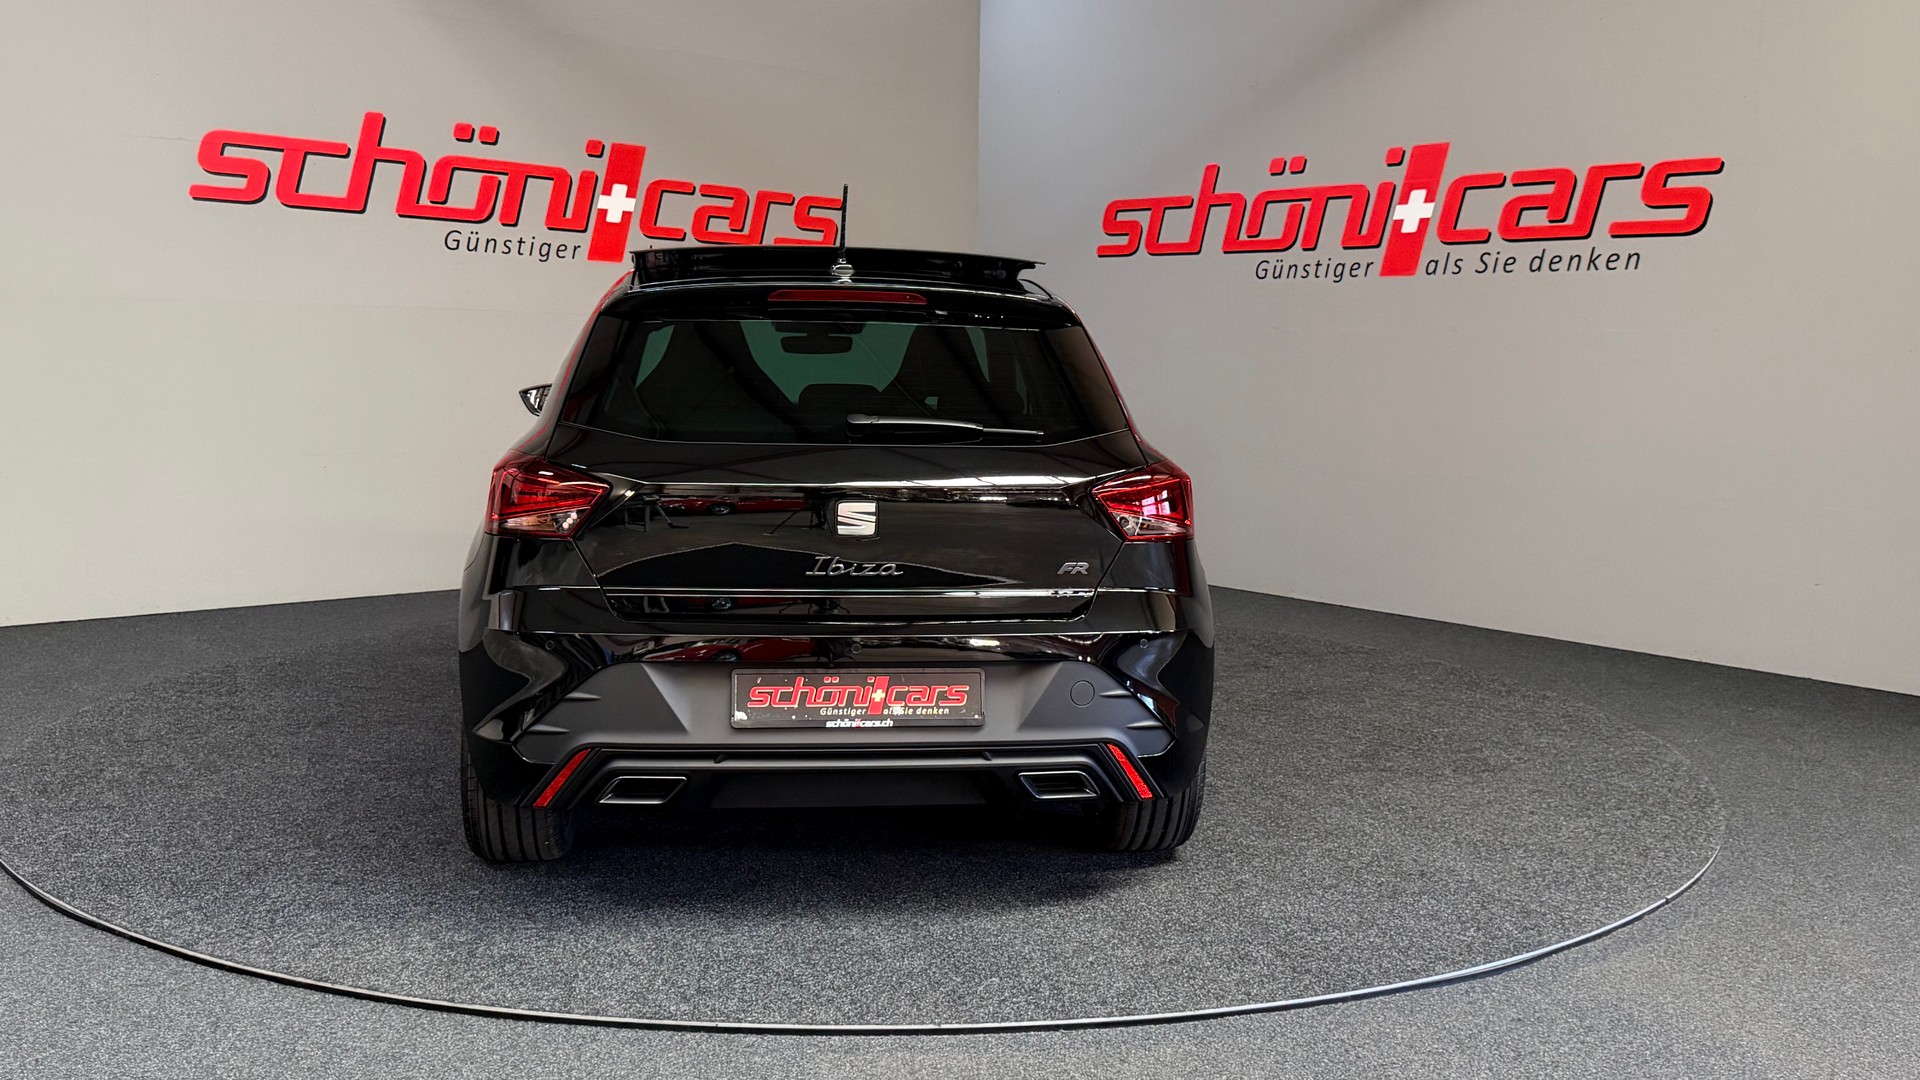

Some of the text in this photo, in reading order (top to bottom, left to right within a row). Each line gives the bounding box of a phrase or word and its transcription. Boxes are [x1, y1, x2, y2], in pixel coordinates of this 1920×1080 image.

[443, 229, 583, 261] Günstiger
[1255, 247, 1642, 282] Günstiger als Sie denken
[805, 556, 904, 576] Ibiza
[1057, 561, 1090, 575] FR
[819, 707, 867, 717] Günstiger
[915, 706, 950, 715] denken
